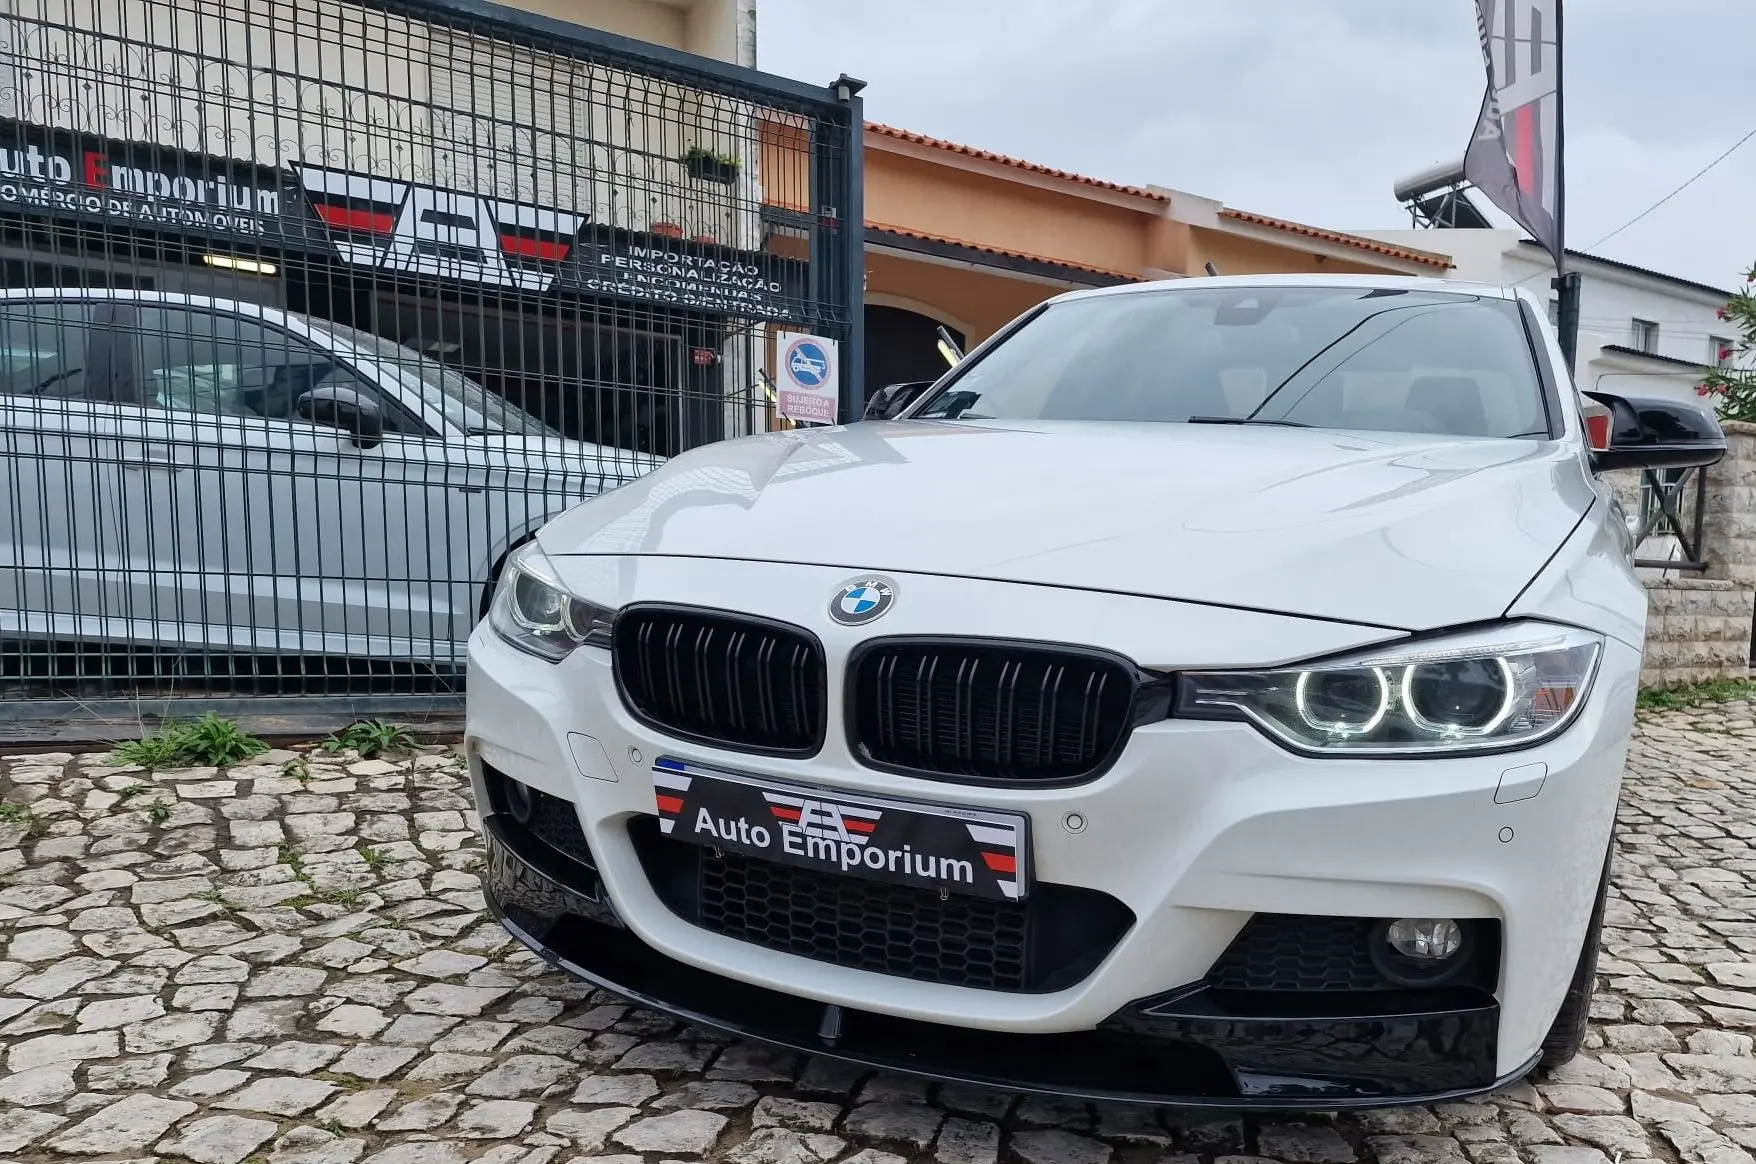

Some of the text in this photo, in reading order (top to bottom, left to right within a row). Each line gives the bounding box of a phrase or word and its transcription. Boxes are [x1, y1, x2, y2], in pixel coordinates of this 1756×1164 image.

[0, 145, 279, 215] uto Emporium
[0, 184, 101, 213] OMÉRCIO
[109, 200, 131, 217] DE
[601, 254, 782, 293] PERSONALIZAÇÃO
[629, 246, 759, 276] IMPORTAÇÃO
[787, 394, 830, 408] SUJEITO A
[787, 405, 829, 418] REBOQUE
[694, 806, 973, 883] Auto Emporium
